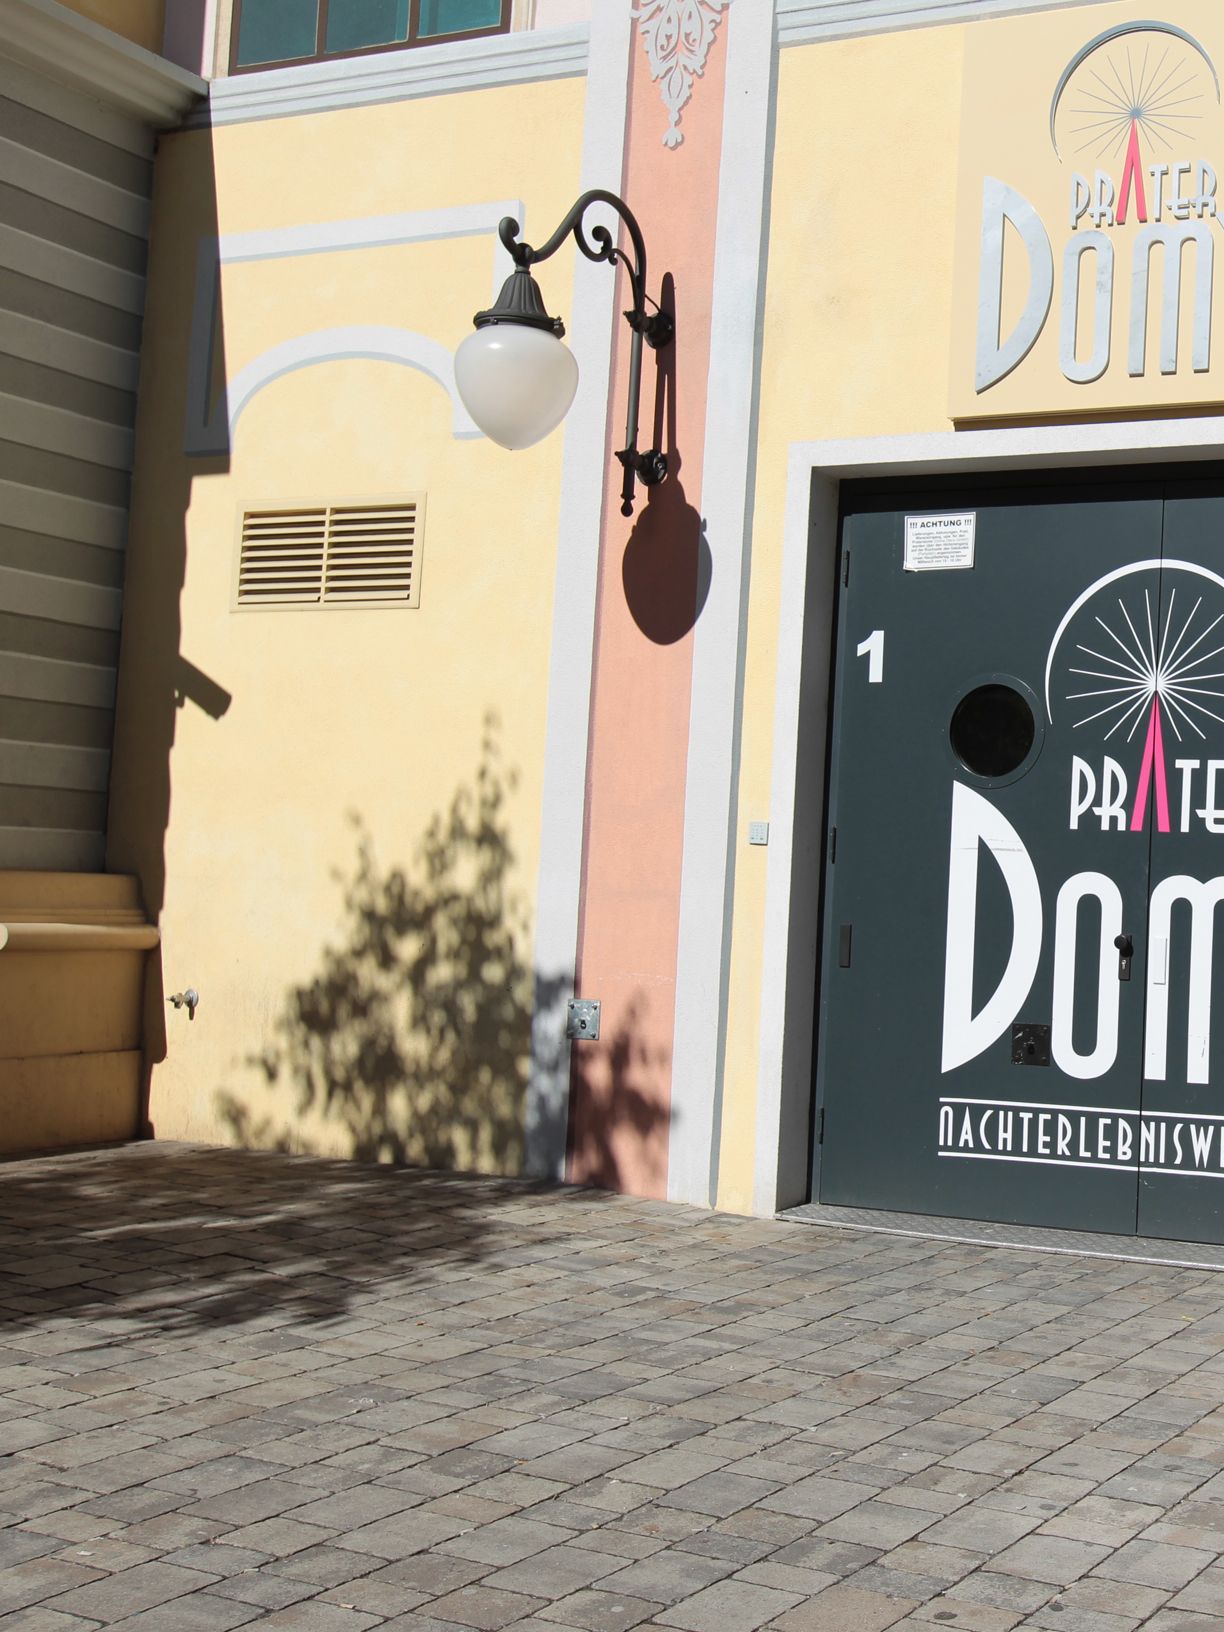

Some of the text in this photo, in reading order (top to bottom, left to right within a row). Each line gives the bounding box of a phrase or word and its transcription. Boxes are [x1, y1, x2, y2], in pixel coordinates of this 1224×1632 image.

[1070, 119, 1217, 230] PRATER
[920, 520, 962, 528] ACHTUNG
[856, 630, 885, 683] 1
